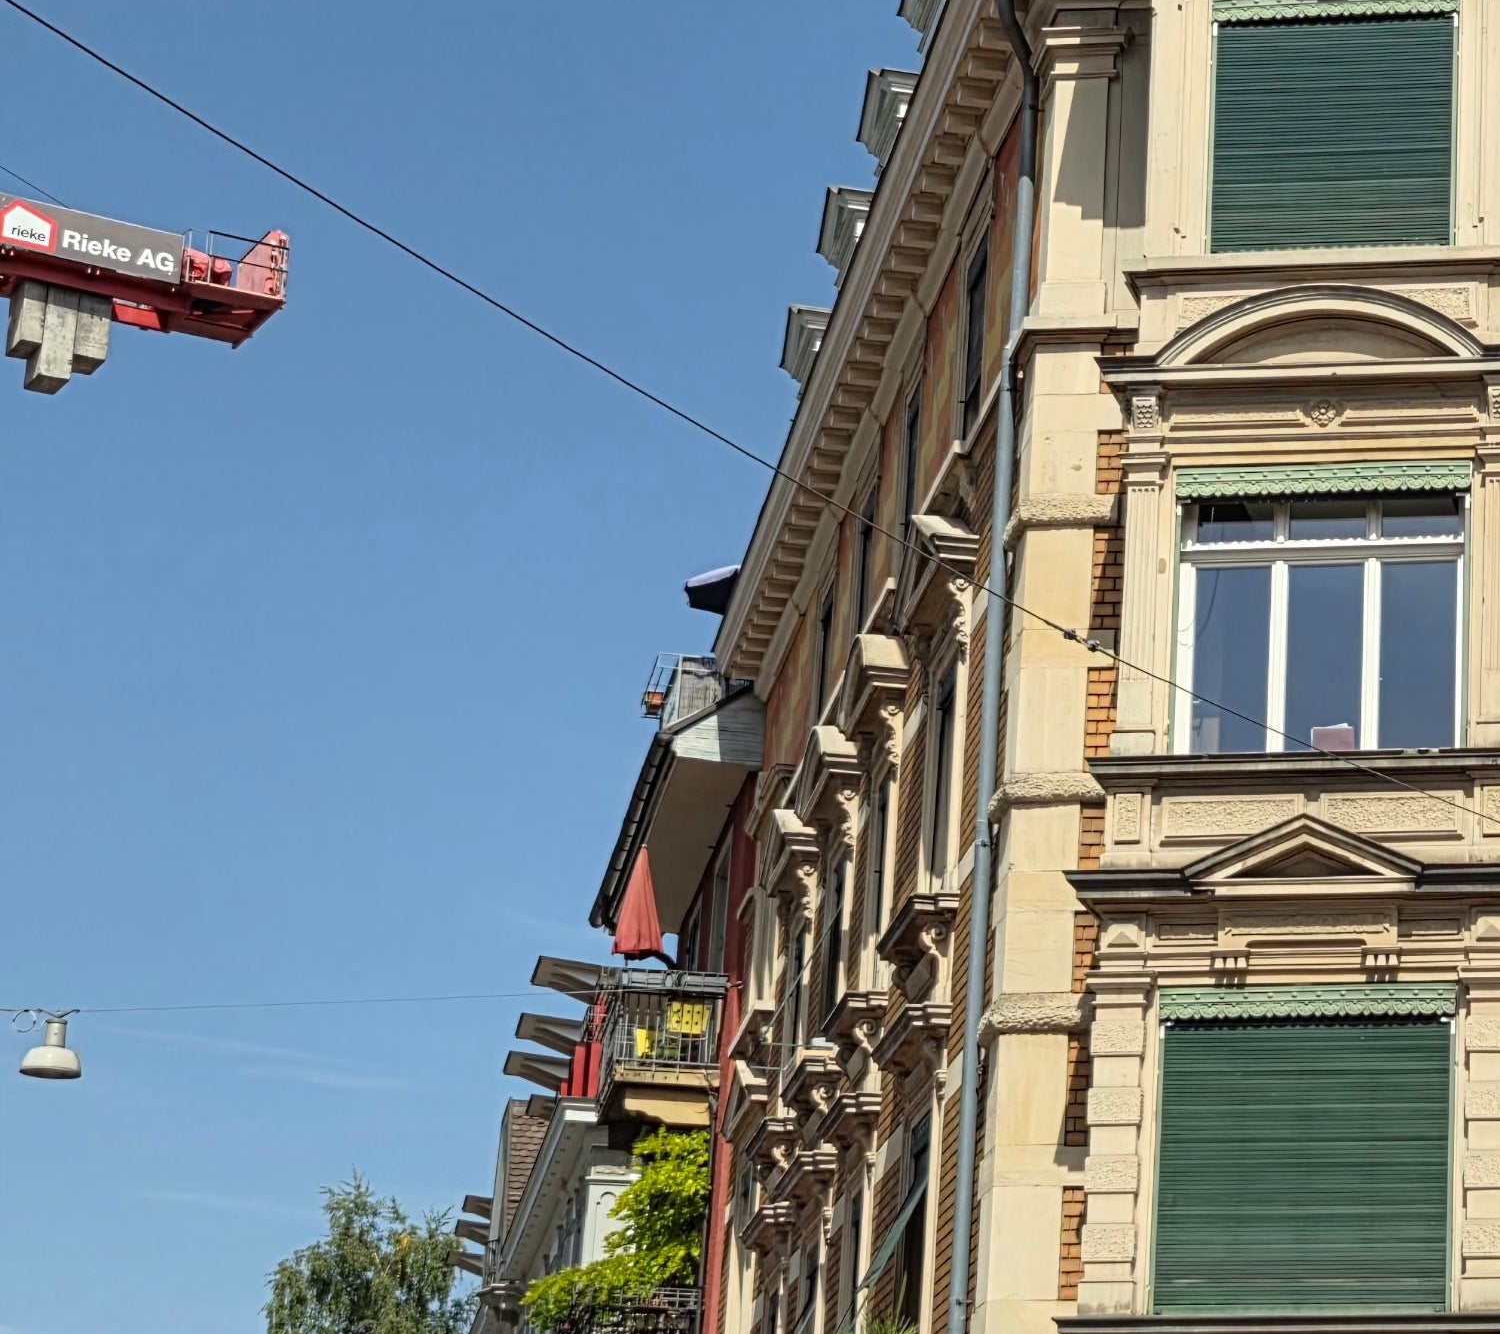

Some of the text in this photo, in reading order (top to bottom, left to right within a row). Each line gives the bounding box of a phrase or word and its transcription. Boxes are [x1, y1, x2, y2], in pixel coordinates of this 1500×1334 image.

[11, 226, 46, 242] rieke
[62, 229, 175, 273] Rieke AG
